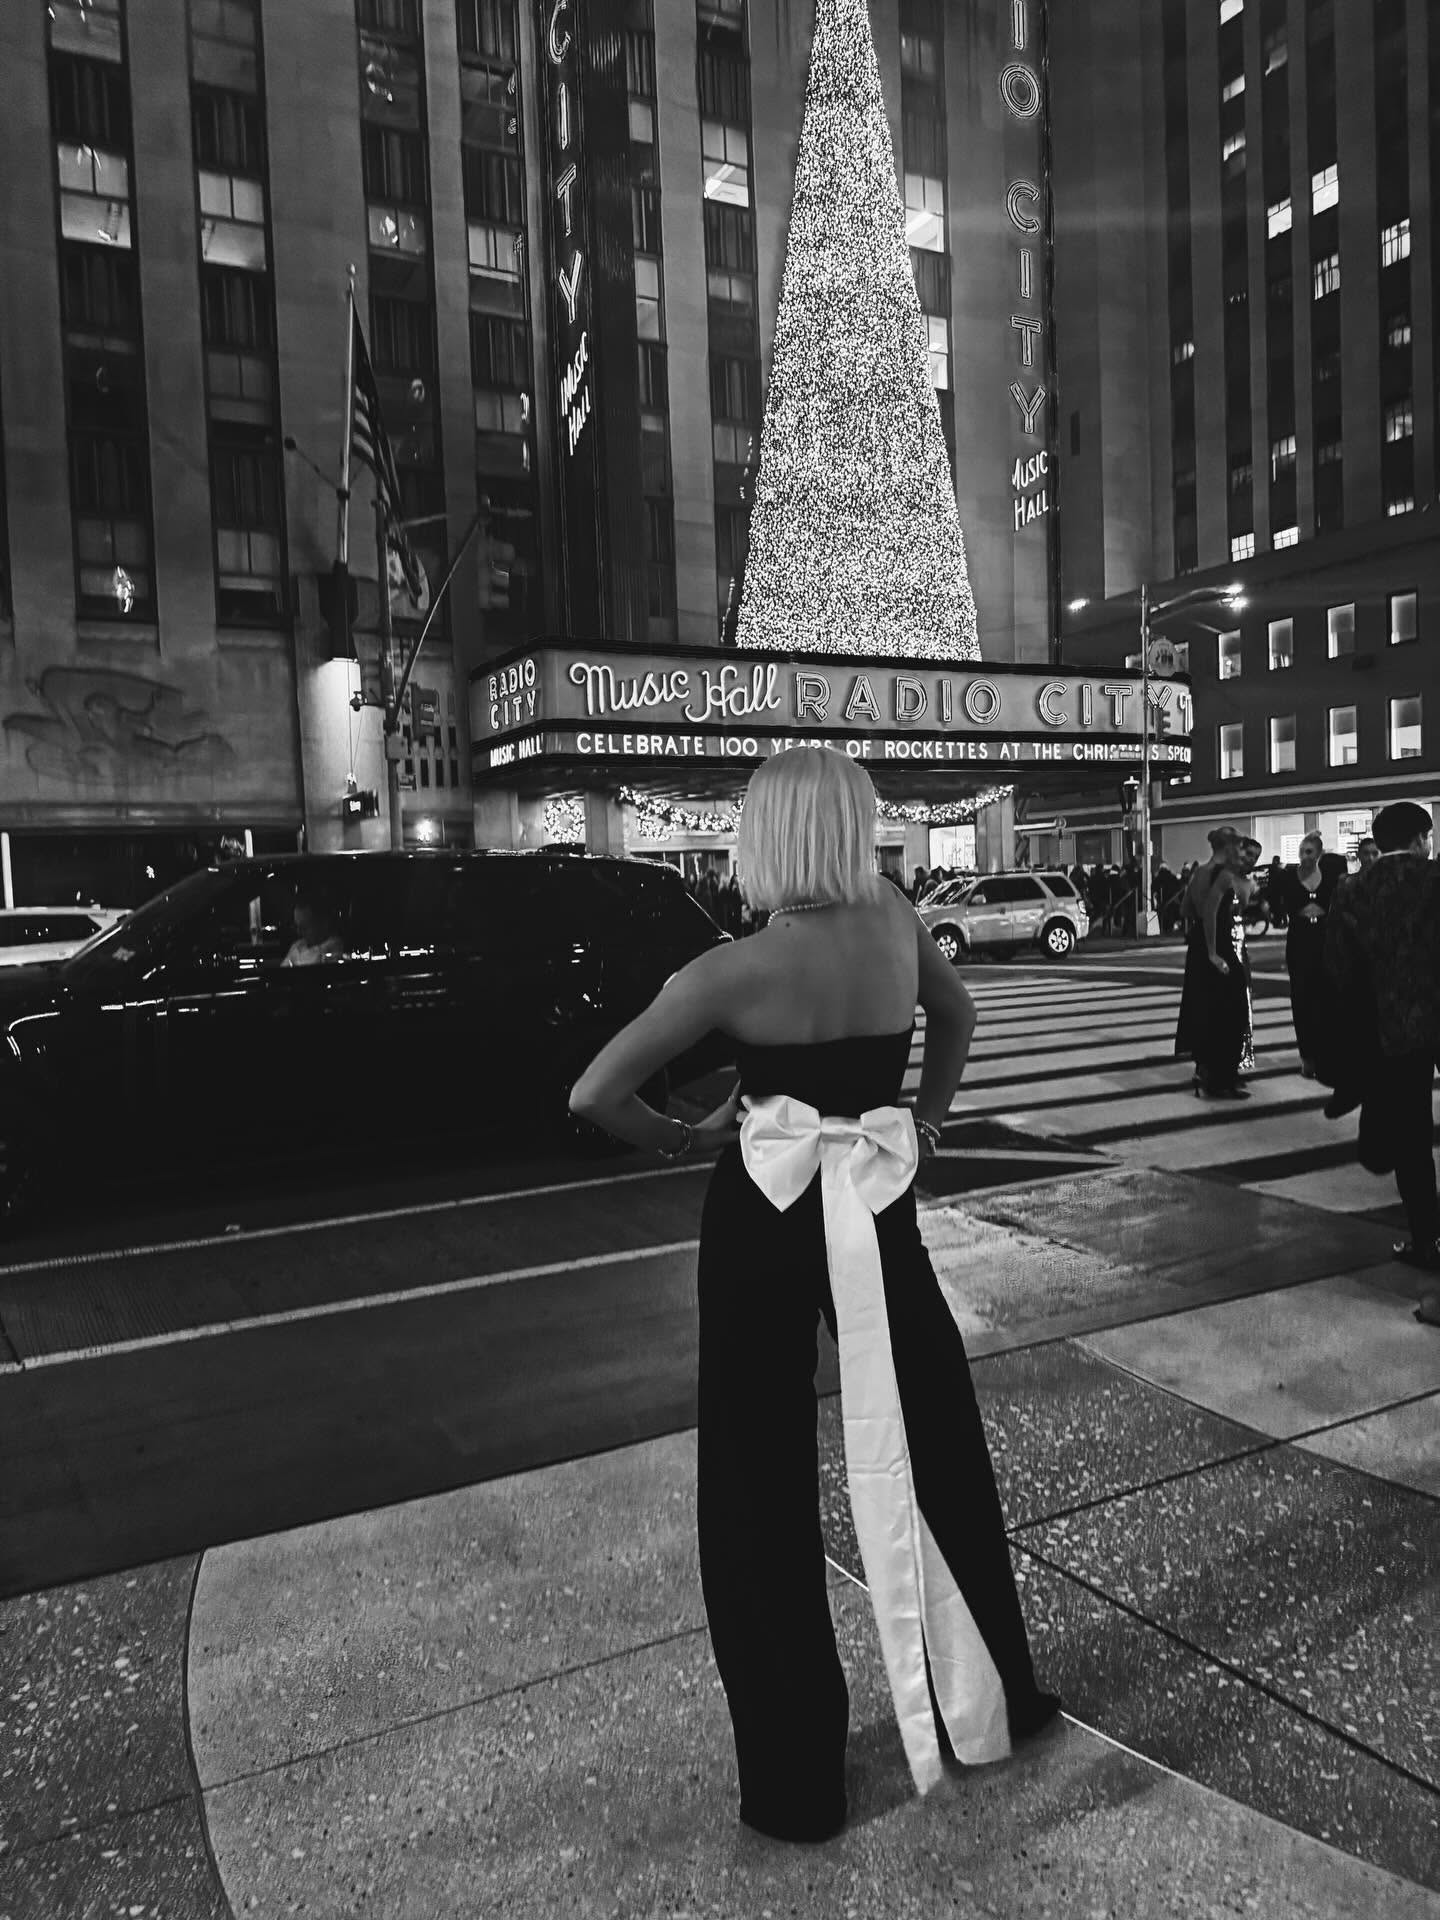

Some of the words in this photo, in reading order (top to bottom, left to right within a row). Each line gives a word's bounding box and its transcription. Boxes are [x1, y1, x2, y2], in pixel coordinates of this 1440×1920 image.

[1006, 180, 1046, 434] CITY
[489, 659, 535, 701] RADIO
[569, 662, 690, 715] Music
[685, 663, 781, 722] Hall
[795, 671, 1001, 725] RADIO
[1036, 681, 1172, 727] CITY
[490, 690, 536, 729] CITY
[490, 743, 515, 767] MUSIC
[519, 734, 542, 759] HALL
[576, 733, 704, 755] CELEBRATE
[720, 737, 758, 756] 100
[846, 740, 872, 758] OF
[884, 740, 988, 760] ROCKETTES
[1000, 742, 1021, 760] AT
[1033, 743, 1062, 760] THE
[1072, 743, 1159, 760] CHRISS
